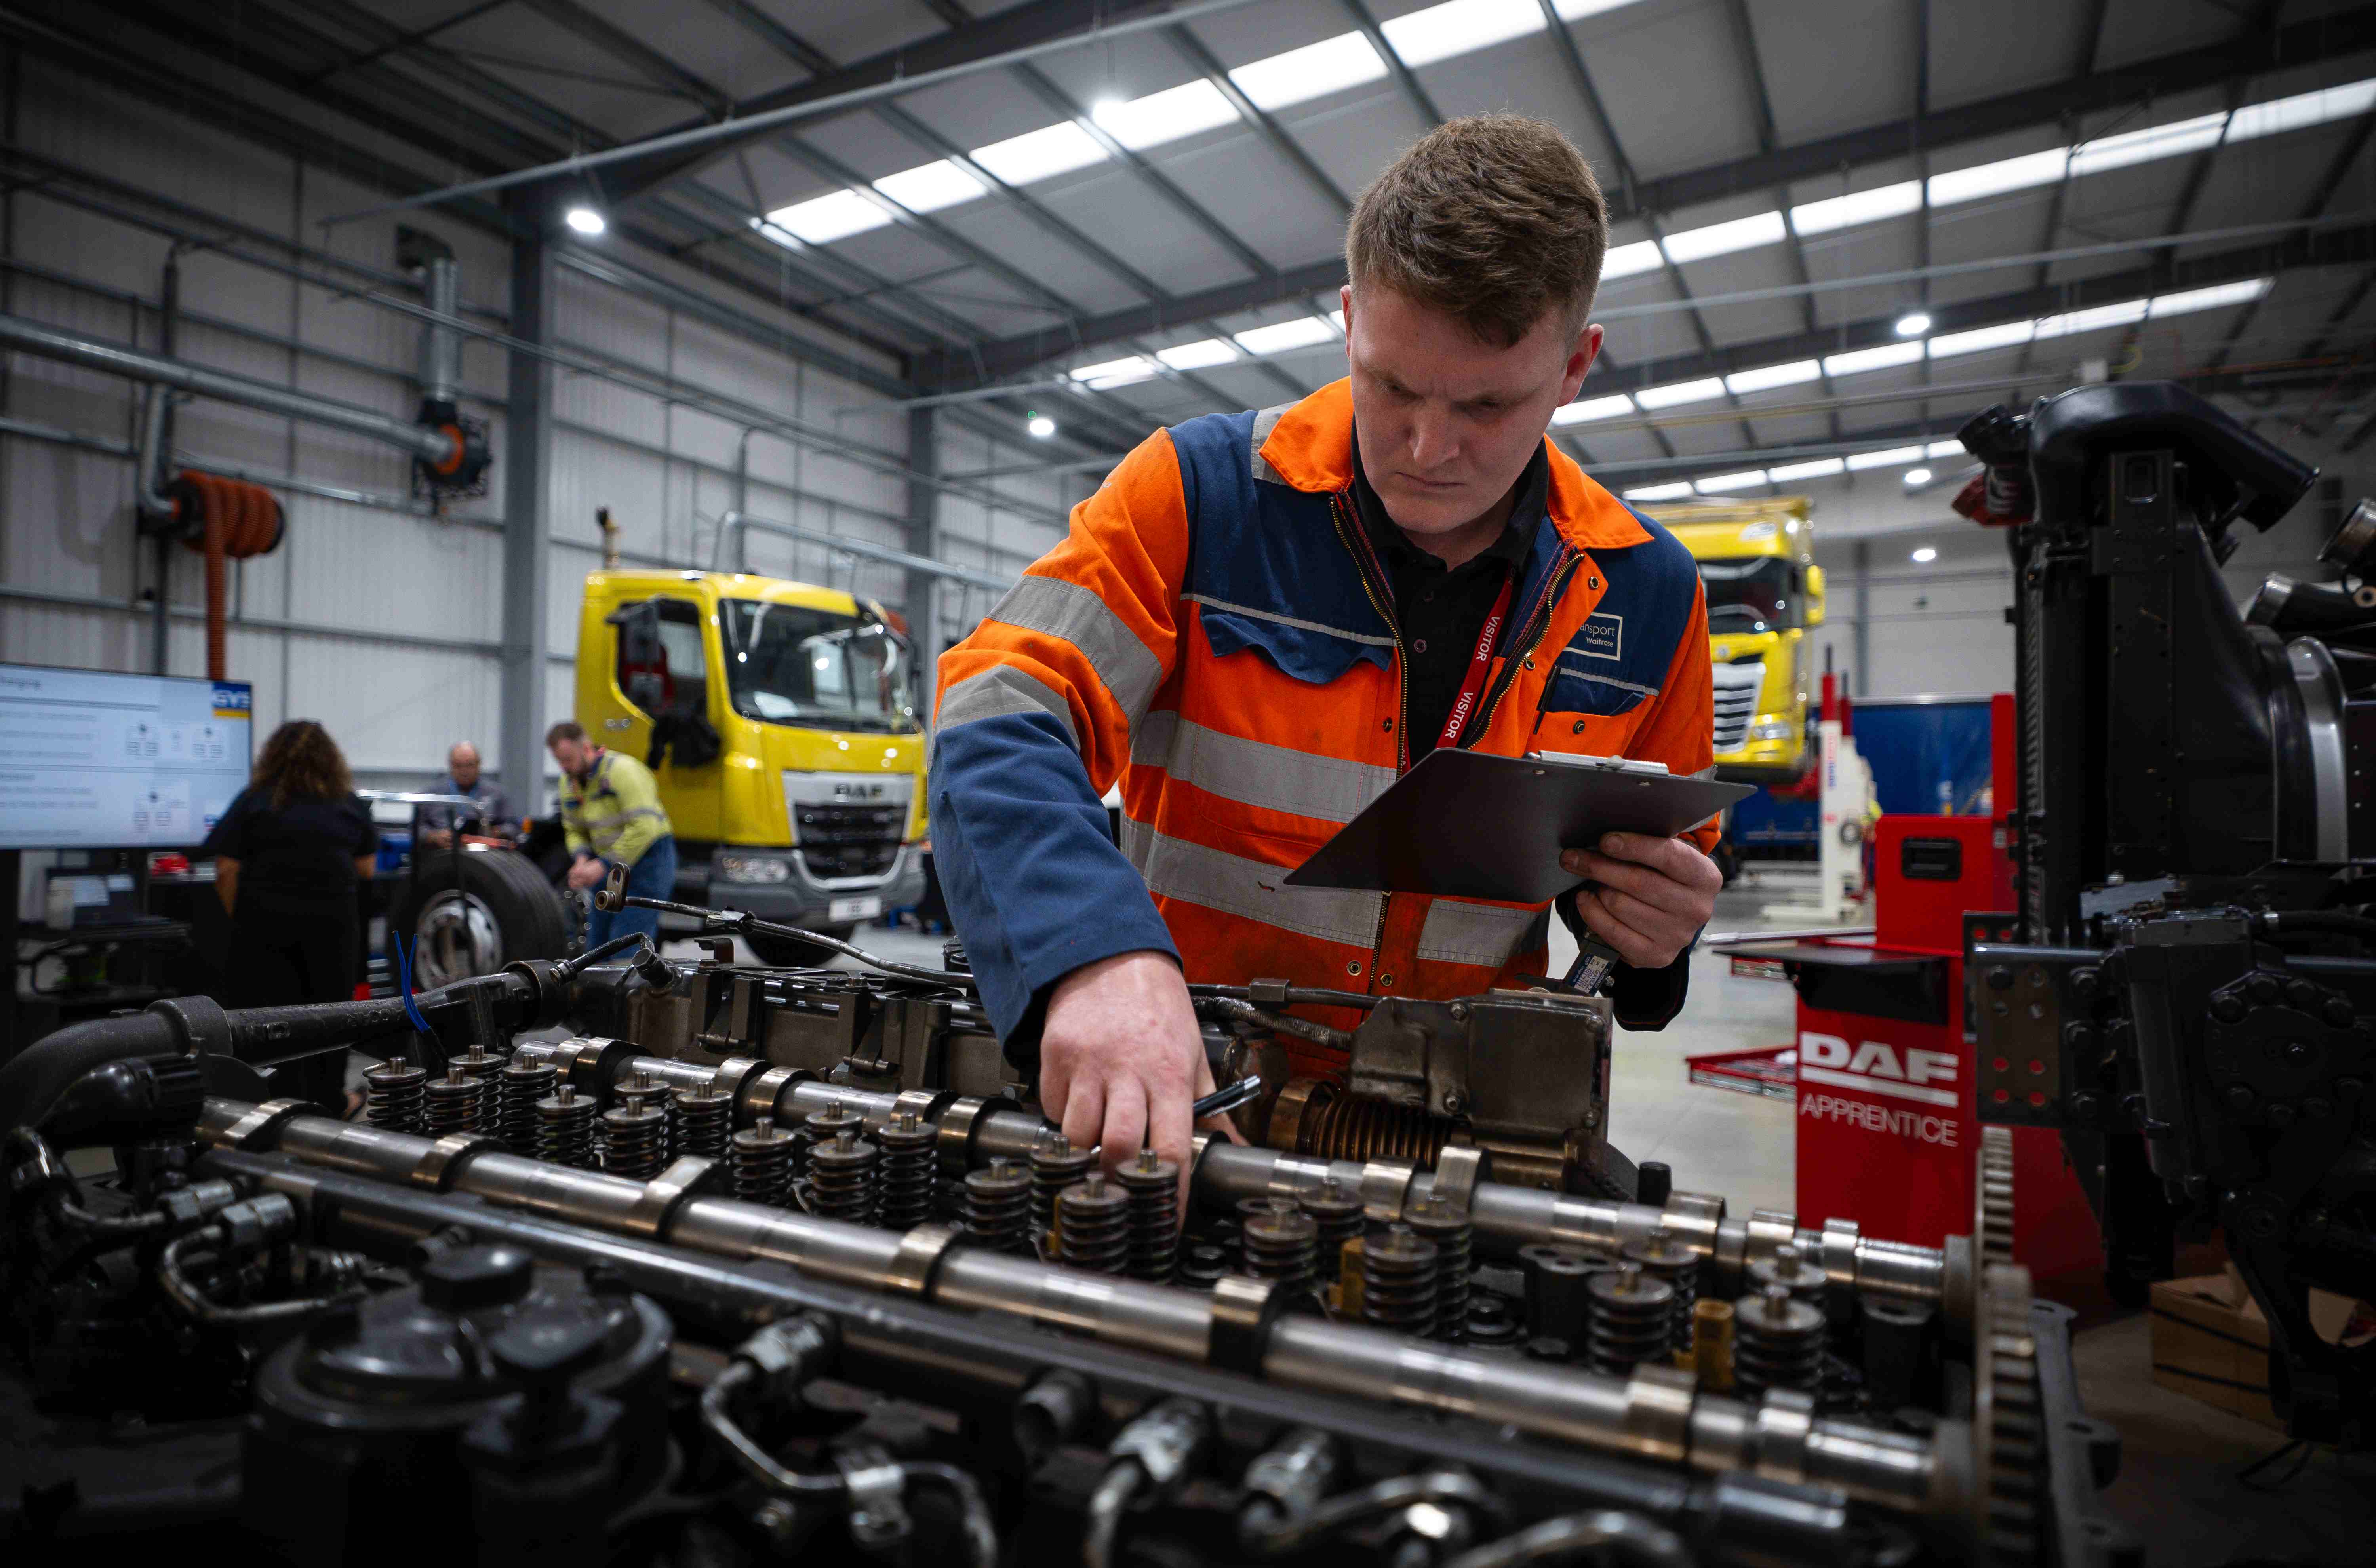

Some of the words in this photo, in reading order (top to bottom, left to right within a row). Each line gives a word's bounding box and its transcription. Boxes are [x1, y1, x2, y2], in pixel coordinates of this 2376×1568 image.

[1476, 617, 1500, 662] VISITOR
[1580, 623, 1615, 637] ansport
[1586, 637, 1613, 647] Waitrose
[1445, 692, 1474, 738] VISITOR
[1799, 1030, 1959, 1084] DAF
[1799, 1092, 1959, 1147] APPRENTICE
